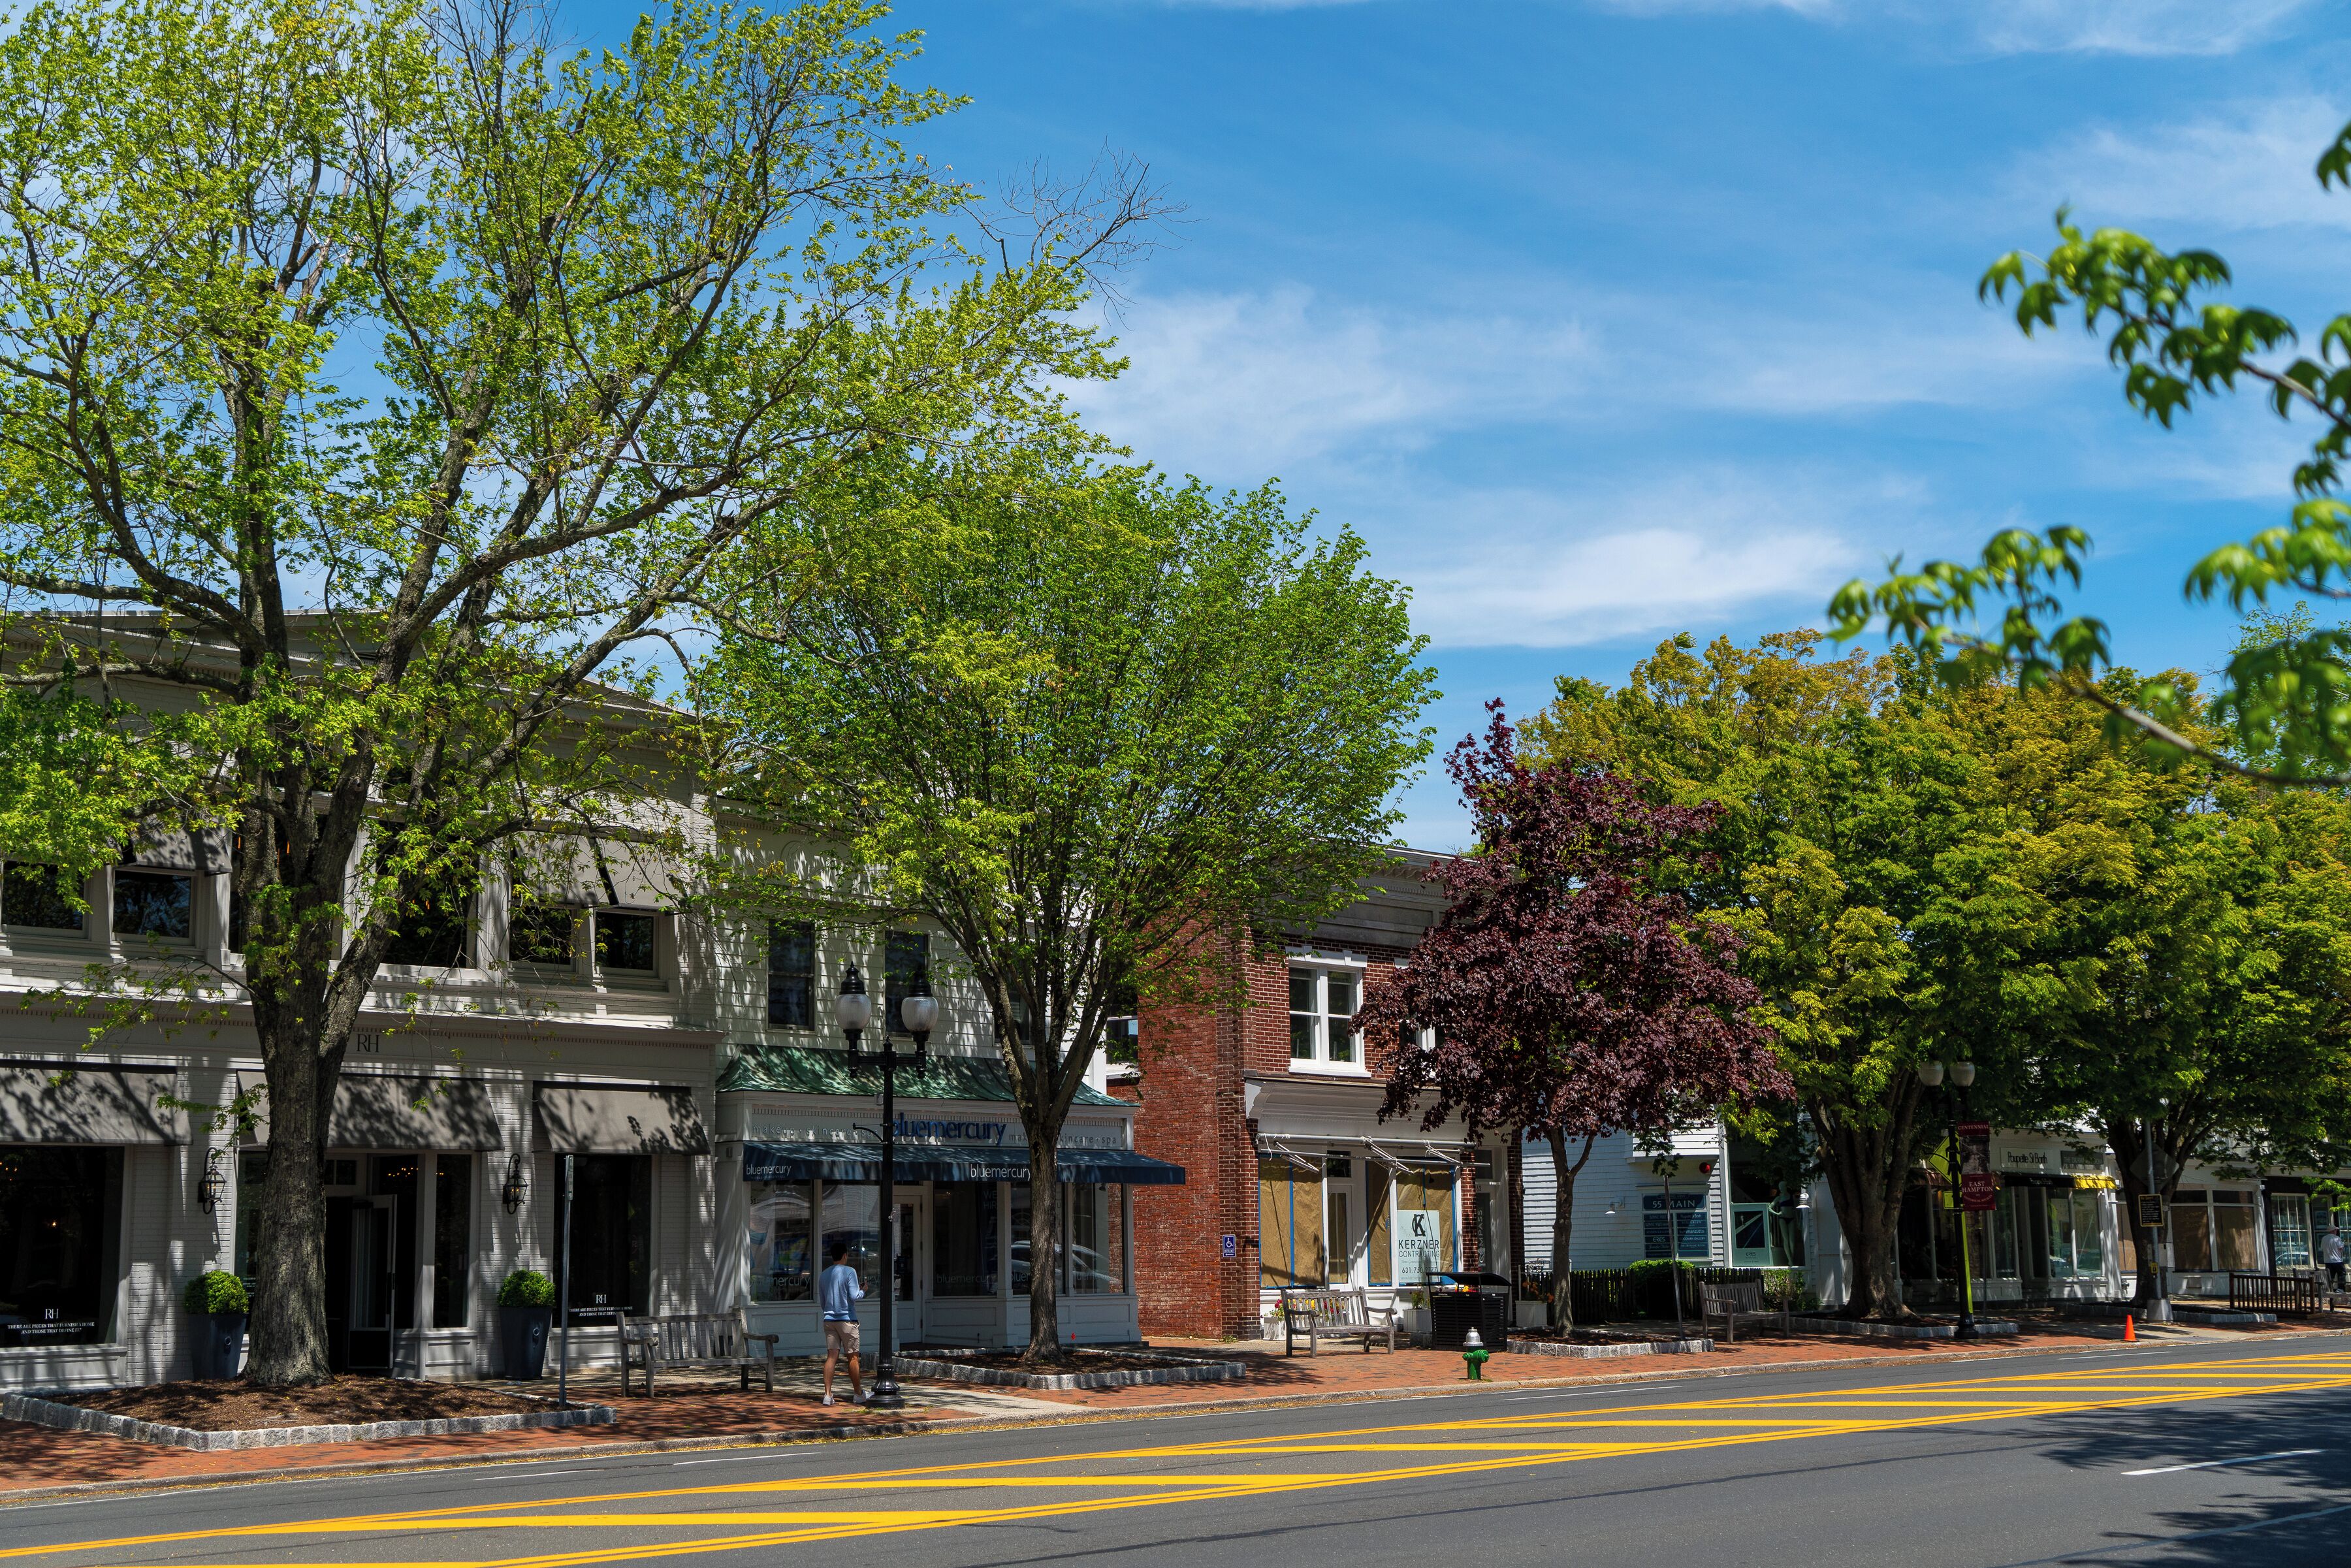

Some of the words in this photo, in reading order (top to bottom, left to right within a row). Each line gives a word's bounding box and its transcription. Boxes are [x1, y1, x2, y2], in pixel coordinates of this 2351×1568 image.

[357, 1034, 379, 1052] RH
[1059, 1134, 1093, 1143] kincare
[1102, 1136, 1117, 1145] spa
[746, 1164, 792, 1176] bluemercury
[1399, 1240, 1439, 1249] KERZNER
[596, 1294, 607, 1304] RH
[45, 1308, 59, 1319] RH
